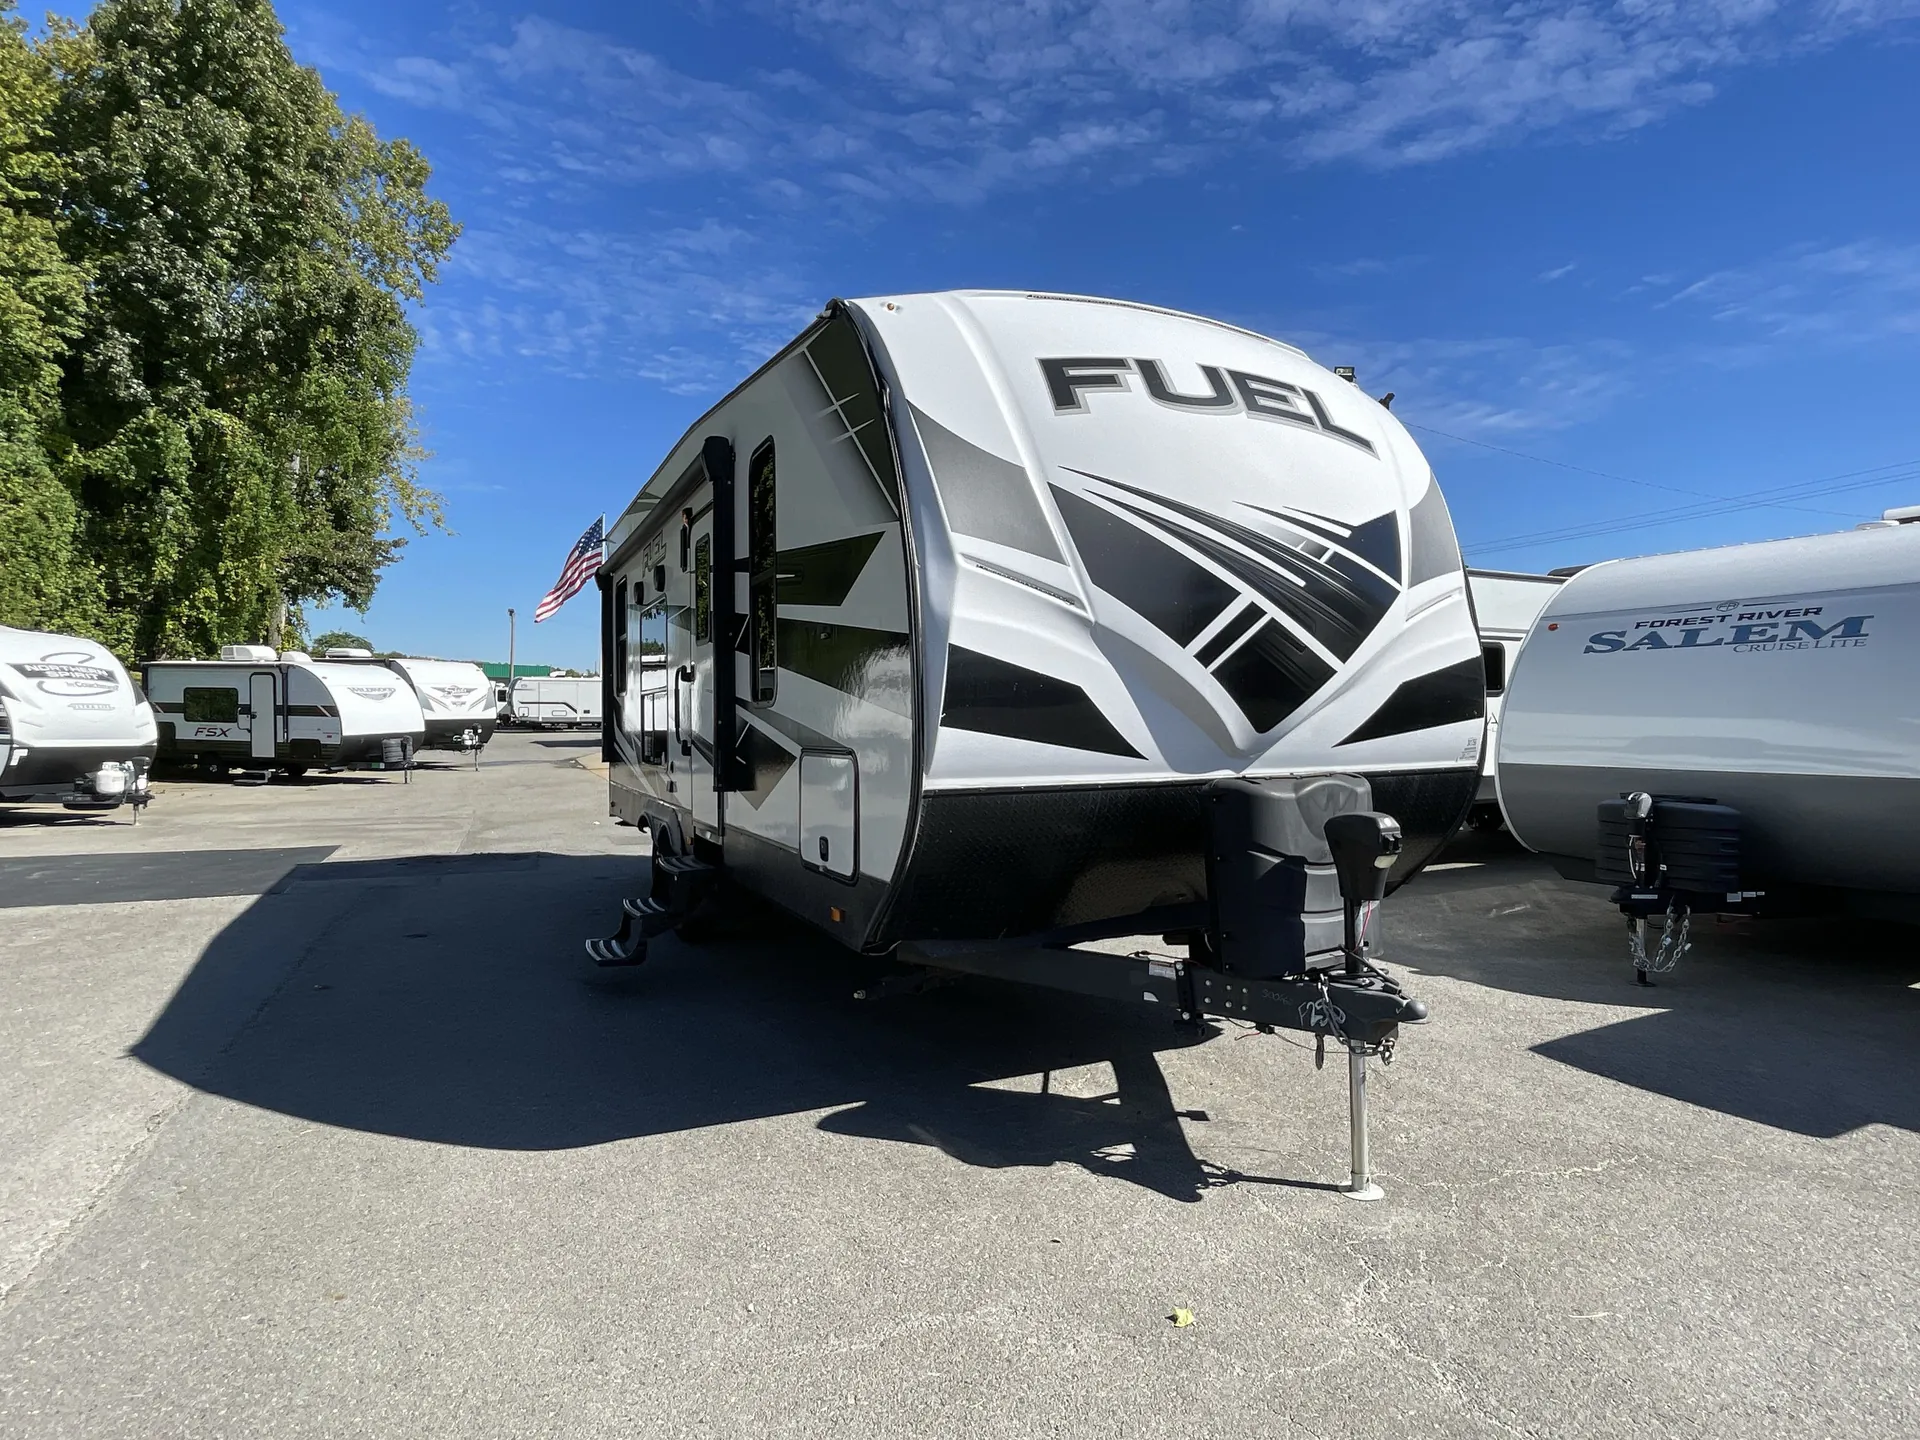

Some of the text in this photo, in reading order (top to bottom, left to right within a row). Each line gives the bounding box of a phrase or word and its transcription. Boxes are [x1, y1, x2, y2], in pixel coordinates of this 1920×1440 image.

[1035, 357, 1381, 461] FUEL
[1634, 607, 1824, 630] FOREST RIVER
[1582, 615, 1875, 655] SALEM
[23, 663, 109, 677] NORTHERN
[44, 670, 99, 680] SPIRIT
[194, 727, 232, 738] FSX
